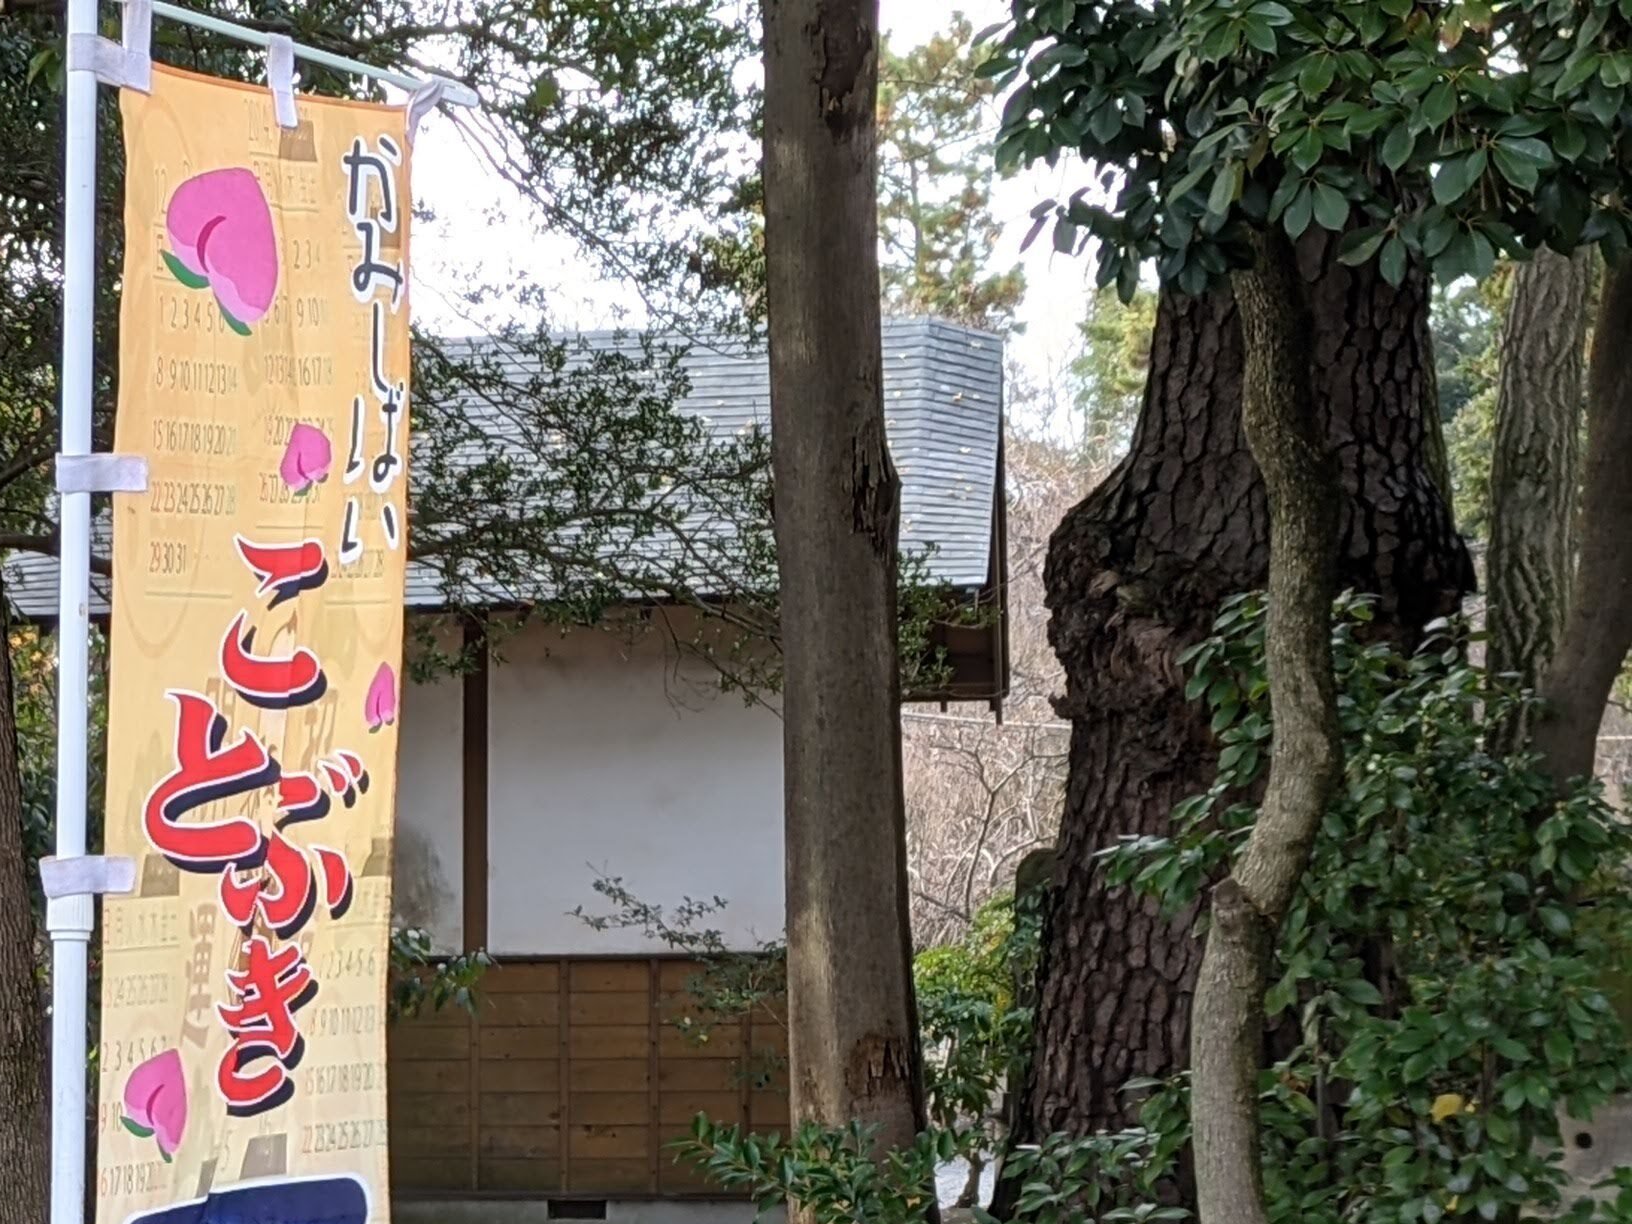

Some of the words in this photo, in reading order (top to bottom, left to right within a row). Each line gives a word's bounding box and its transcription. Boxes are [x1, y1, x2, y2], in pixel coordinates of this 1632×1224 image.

[171, 297, 177, 328] 2
[183, 299, 189, 329] 3
[194, 303, 200, 326] 4
[207, 302, 213, 332] 5
[296, 297, 304, 328] 9
[340, 136, 403, 554] かみしばい
[156, 356, 163, 387] 8
[170, 359, 177, 389] 9
[180, 361, 190, 391] 10
[193, 362, 202, 391] 11
[205, 363, 214, 393] 12
[216, 364, 226, 395] 13
[298, 357, 311, 386] 16
[312, 356, 322, 385] 17
[166, 420, 177, 452] 16
[179, 422, 189, 451] 17
[190, 423, 201, 453] 18
[203, 424, 214, 455] 19
[162, 542, 174, 574] 30
[142, 530, 369, 1117] ことぶき
[115, 1040, 122, 1071] 3
